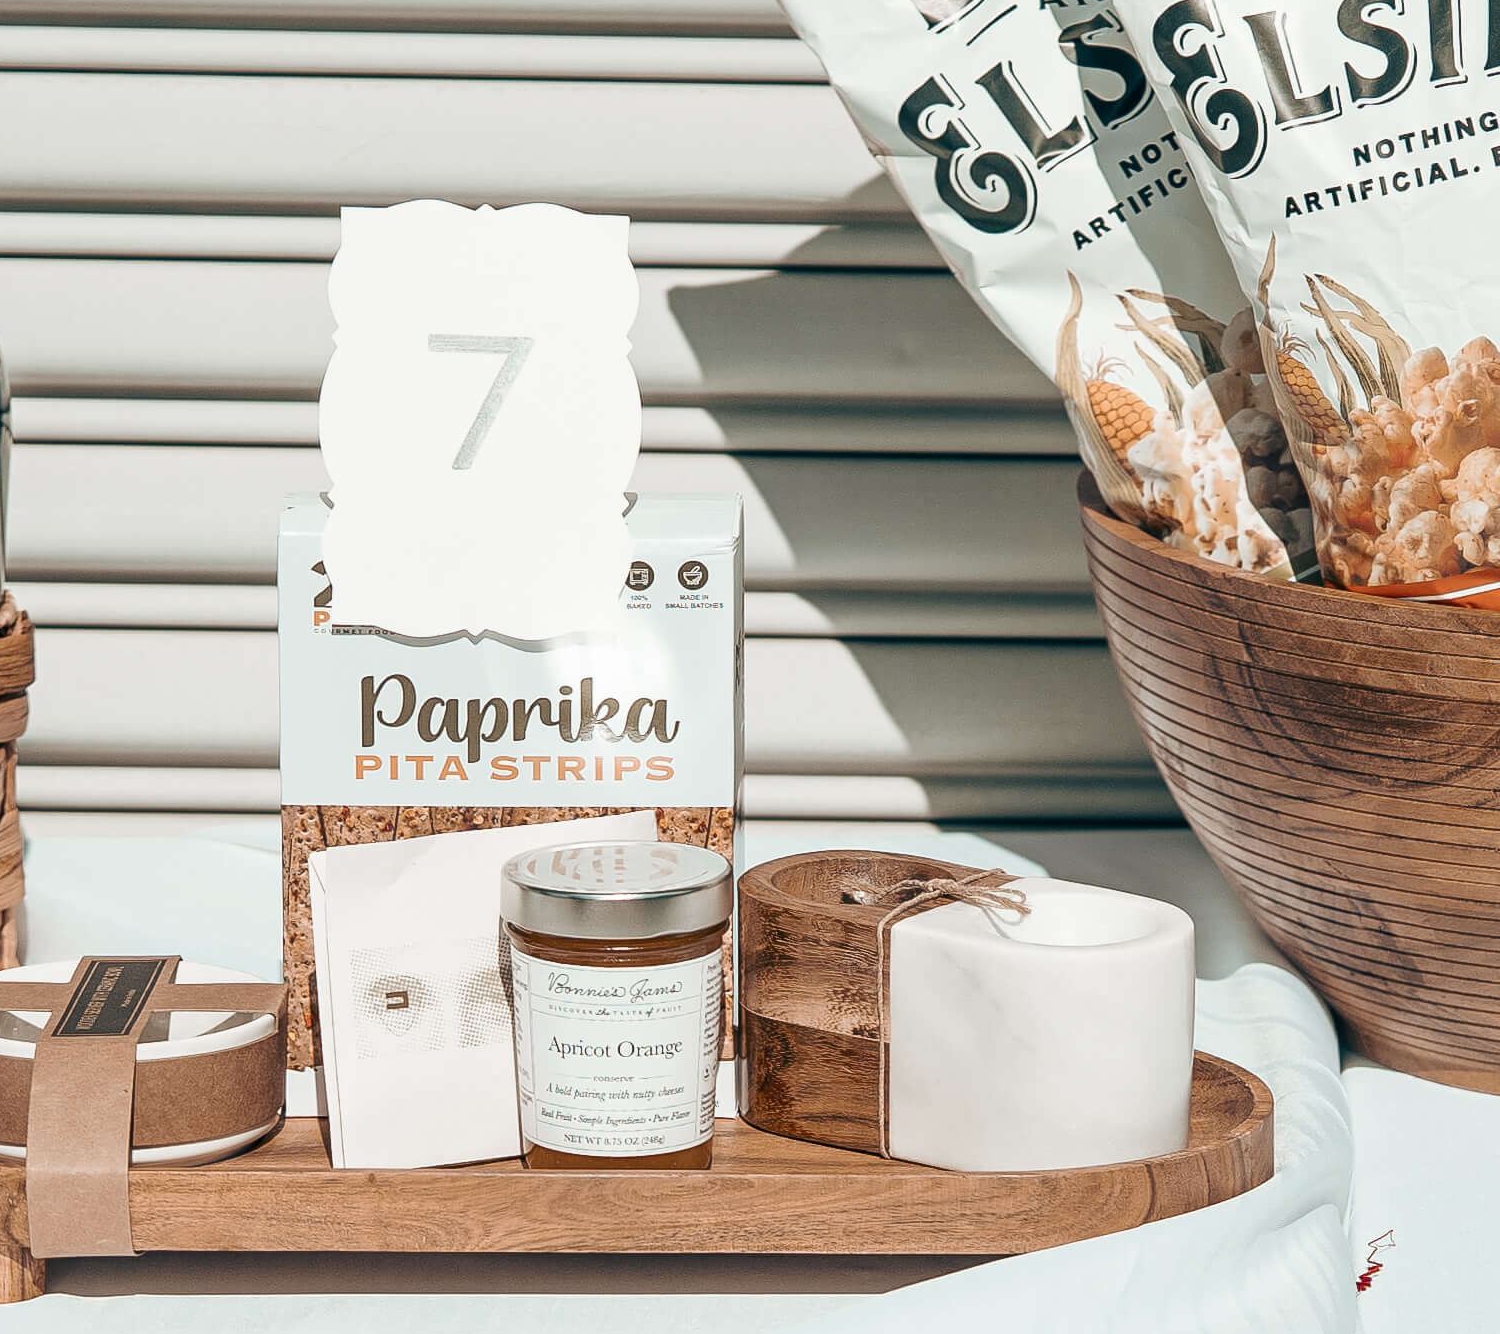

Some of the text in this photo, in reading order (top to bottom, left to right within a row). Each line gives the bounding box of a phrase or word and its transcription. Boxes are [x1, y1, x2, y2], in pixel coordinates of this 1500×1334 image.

[898, 8, 1155, 236] ELS
[1352, 111, 1500, 167] NOTHING
[1118, 131, 1181, 179] NOT
[1071, 163, 1196, 250] ARTIFIC
[1284, 155, 1481, 218] ARTIFICIAL.
[427, 334, 536, 470] 7
[360, 673, 681, 764] Paprika
[354, 754, 676, 782] PITA STRIPS
[548, 972, 683, 1004] Bonnie's Jams
[595, 1007, 611, 1016] the
[548, 1035, 683, 1060] Apricot Orange
[546, 1082, 553, 1093] A
[555, 1084, 573, 1096] bold
[573, 1088, 606, 1102] pairing
[609, 1088, 630, 1100] with
[633, 1090, 655, 1102] nutty
[593, 1075, 636, 1083] conserve
[563, 1133, 583, 1145] NET
[584, 1135, 602, 1145] WT
[624, 1135, 640, 1145] OZ
